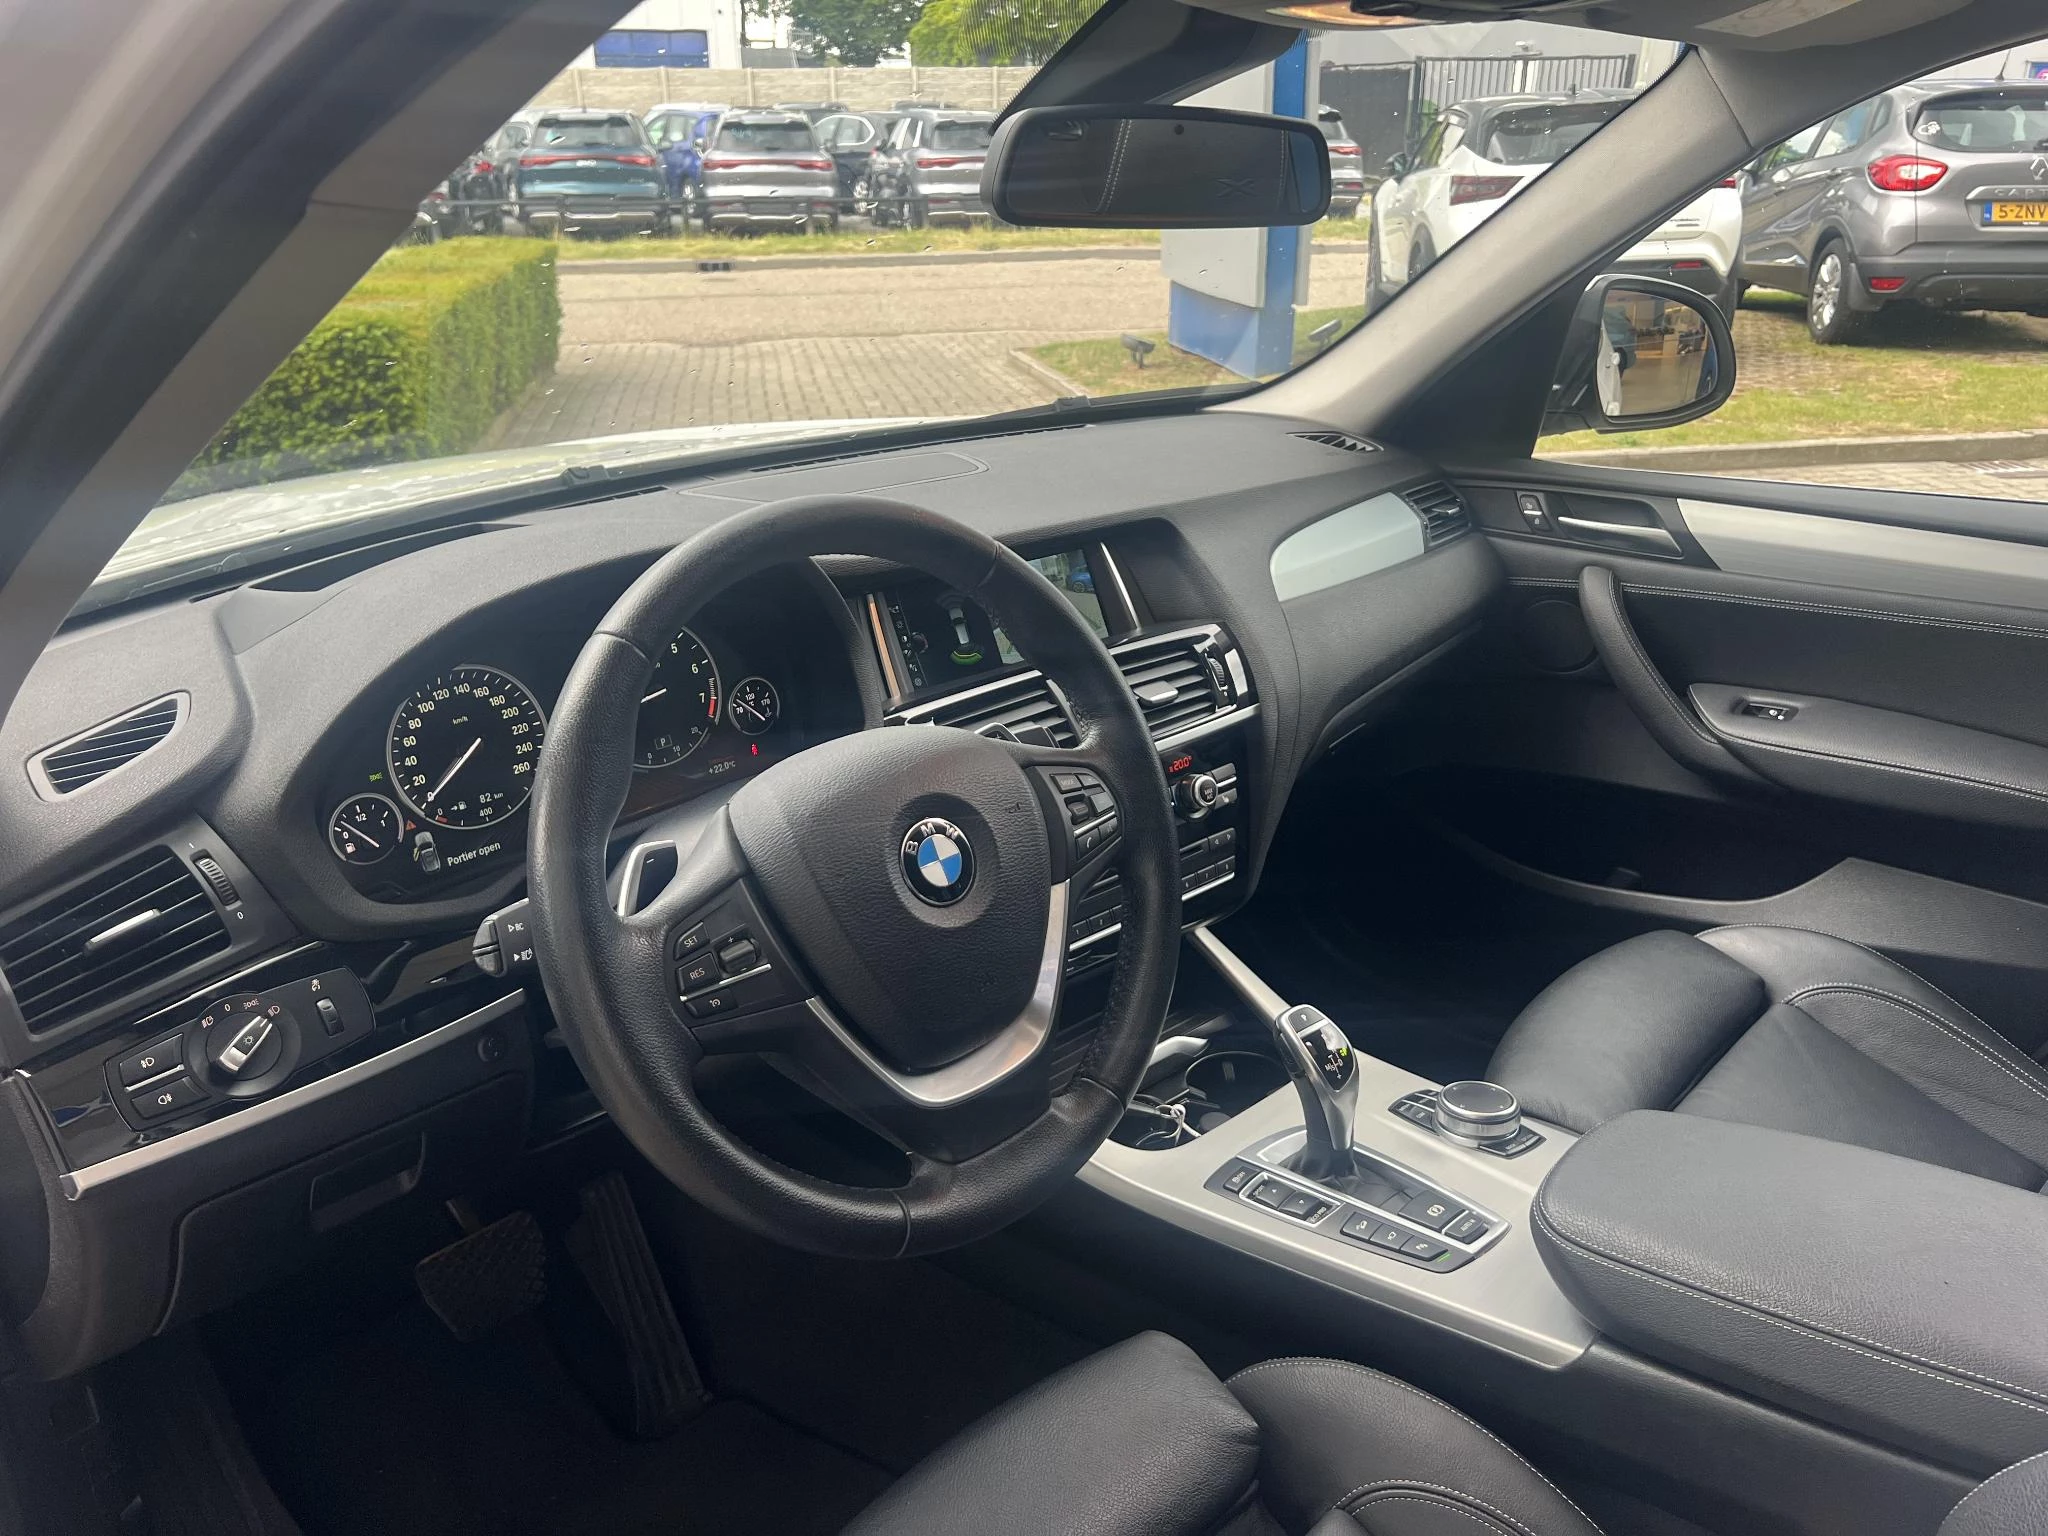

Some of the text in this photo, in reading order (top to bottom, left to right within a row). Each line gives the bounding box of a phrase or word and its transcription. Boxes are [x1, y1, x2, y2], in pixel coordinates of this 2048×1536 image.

[1998, 204, 2047, 219] 5-ZNV
[671, 643, 678, 654] 5
[691, 663, 699, 674] 6
[433, 688, 450, 701] 120
[453, 682, 470, 695] 140
[473, 686, 490, 699] 160
[489, 695, 506, 707] 180
[699, 692, 705, 703] 7
[417, 701, 435, 714] 100
[502, 706, 519, 719] 200
[408, 718, 422, 730] 80
[512, 722, 529, 735] 220
[403, 735, 417, 748] 60
[515, 741, 533, 754] 240
[660, 738, 666, 746] P
[404, 755, 418, 766] 40
[513, 761, 530, 775] 260
[412, 774, 426, 787] 20
[479, 792, 504, 804] 82 km
[356, 813, 368, 822] 1/2
[479, 807, 493, 817] 400
[343, 831, 349, 840] 0
[905, 822, 960, 856] BMW
[447, 842, 501, 867] Portier open
[683, 935, 698, 948] SET
[689, 967, 705, 981] RES
